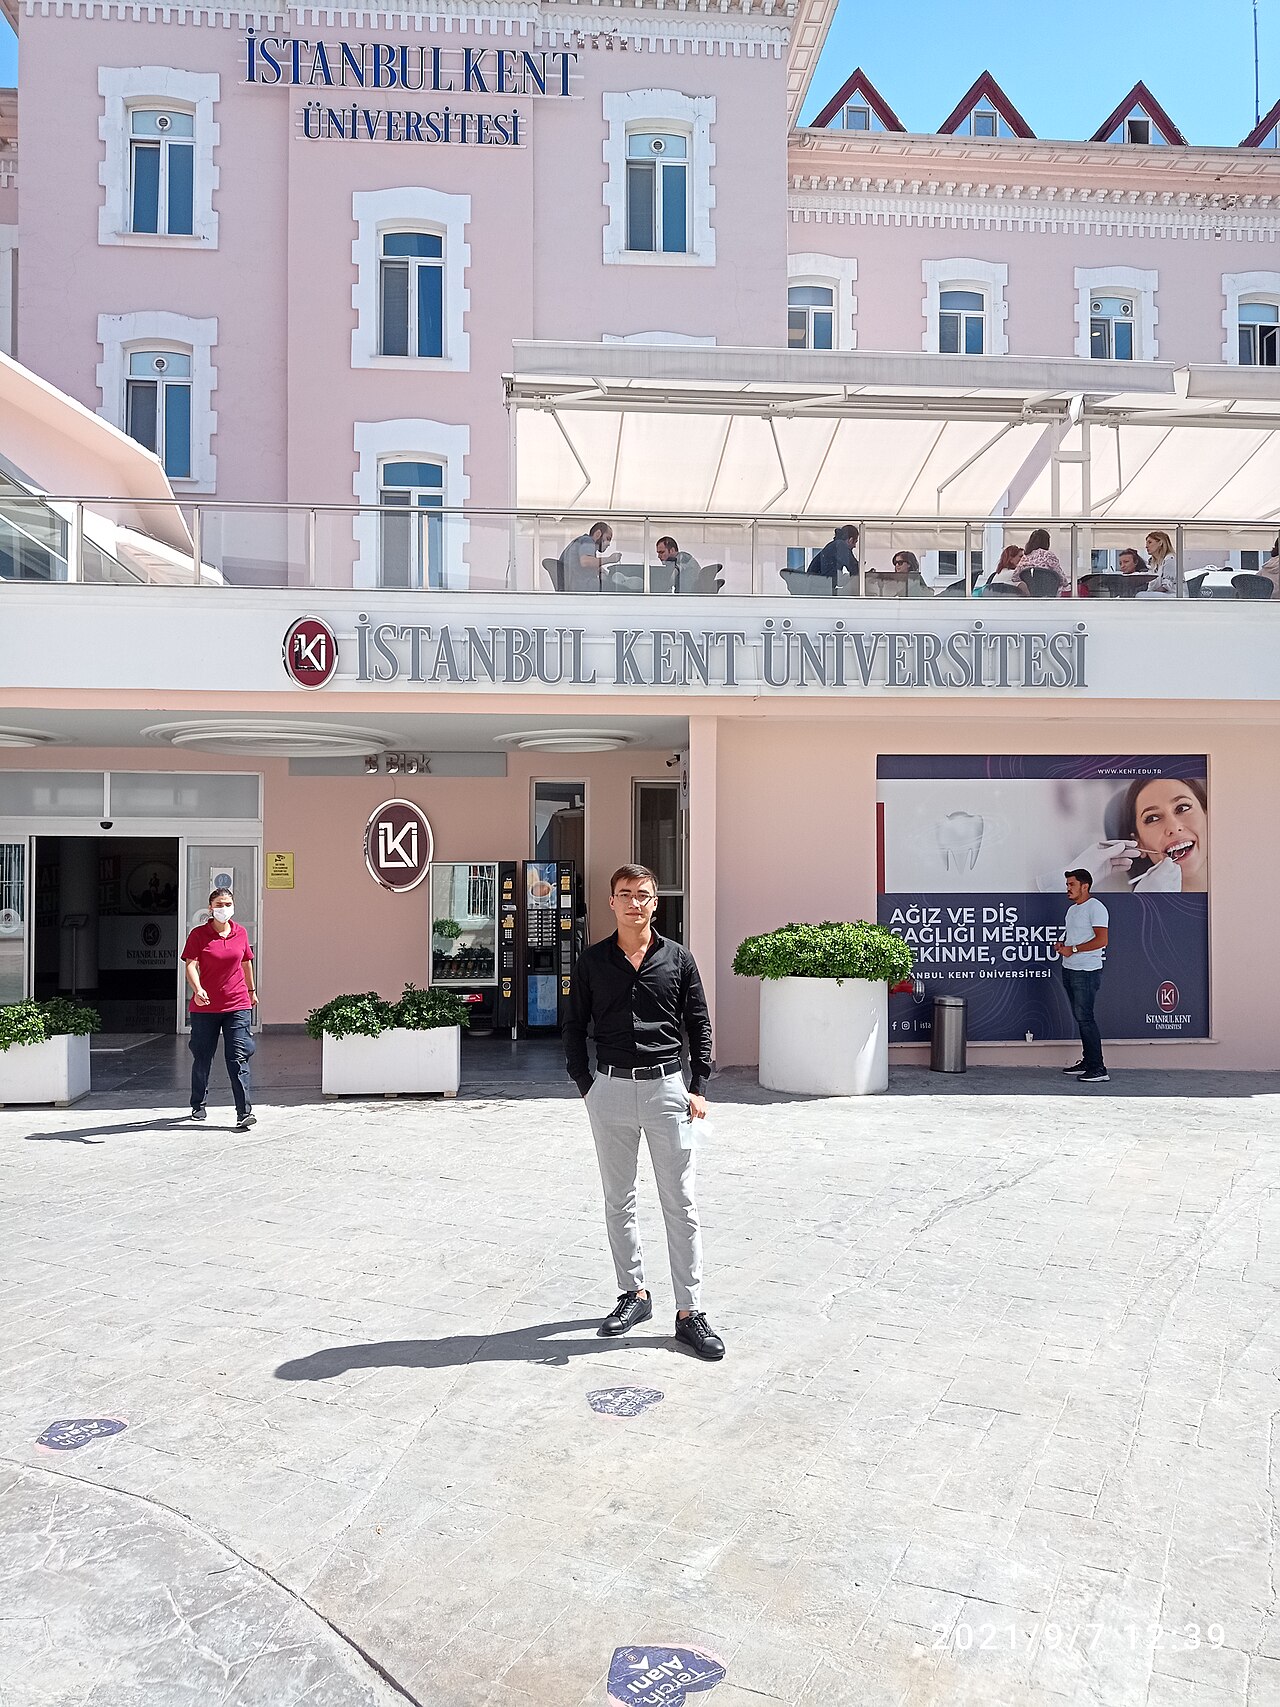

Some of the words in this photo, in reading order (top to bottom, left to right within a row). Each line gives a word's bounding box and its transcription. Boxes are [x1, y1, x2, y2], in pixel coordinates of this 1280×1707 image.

[244, 27, 453, 91] İSTANBUL
[461, 47, 578, 97] KENT
[302, 101, 520, 146] ÜNİVERSİTESİ
[353, 612, 597, 684] İSTANBUL
[611, 629, 747, 688] KENT
[760, 618, 1089, 689] ÜNİVERSİTESİ
[364, 753, 379, 774] B
[386, 752, 432, 774] Blok
[889, 904, 942, 924] AĞIZ
[946, 907, 976, 924] VE
[982, 903, 1018, 927] DİŞ
[982, 926, 1067, 943] MERKEZ
[909, 942, 996, 965] EKİNME,
[948, 971, 976, 979] KENT
[979, 968, 1051, 979] ÜNİVERSİTESİ
[1145, 1013, 1175, 1024] İSTANBUL
[1174, 1014, 1191, 1024] KENT
[642, 1667, 706, 1704] Tercih
